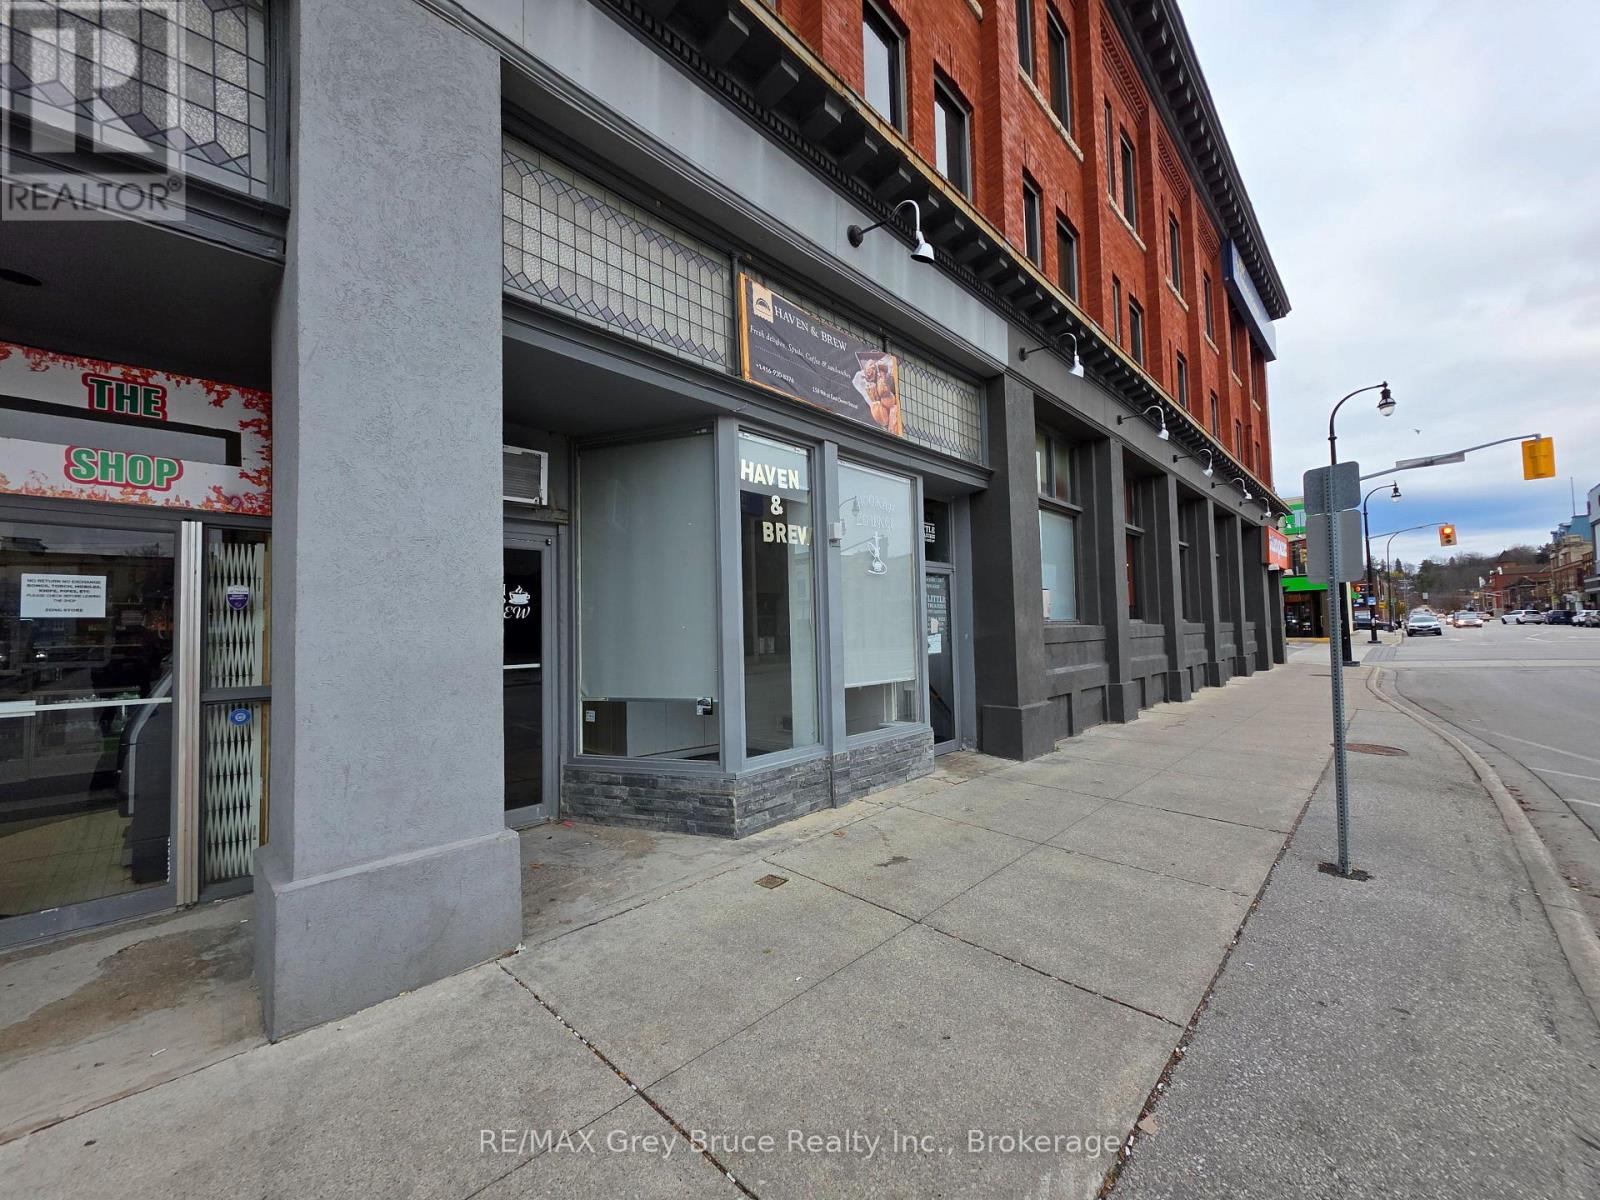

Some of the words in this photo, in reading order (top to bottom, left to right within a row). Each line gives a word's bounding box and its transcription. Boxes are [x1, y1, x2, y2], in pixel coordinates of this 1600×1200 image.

[773, 305, 809, 332] HAVEN
[810, 326, 820, 338] &
[821, 330, 847, 351] BREW
[87, 376, 164, 418] THE
[69, 447, 179, 489] SHOP
[741, 459, 800, 490] HAVEN
[770, 495, 783, 515] &
[762, 521, 812, 546] BREW
[503, 606, 530, 619] EW
